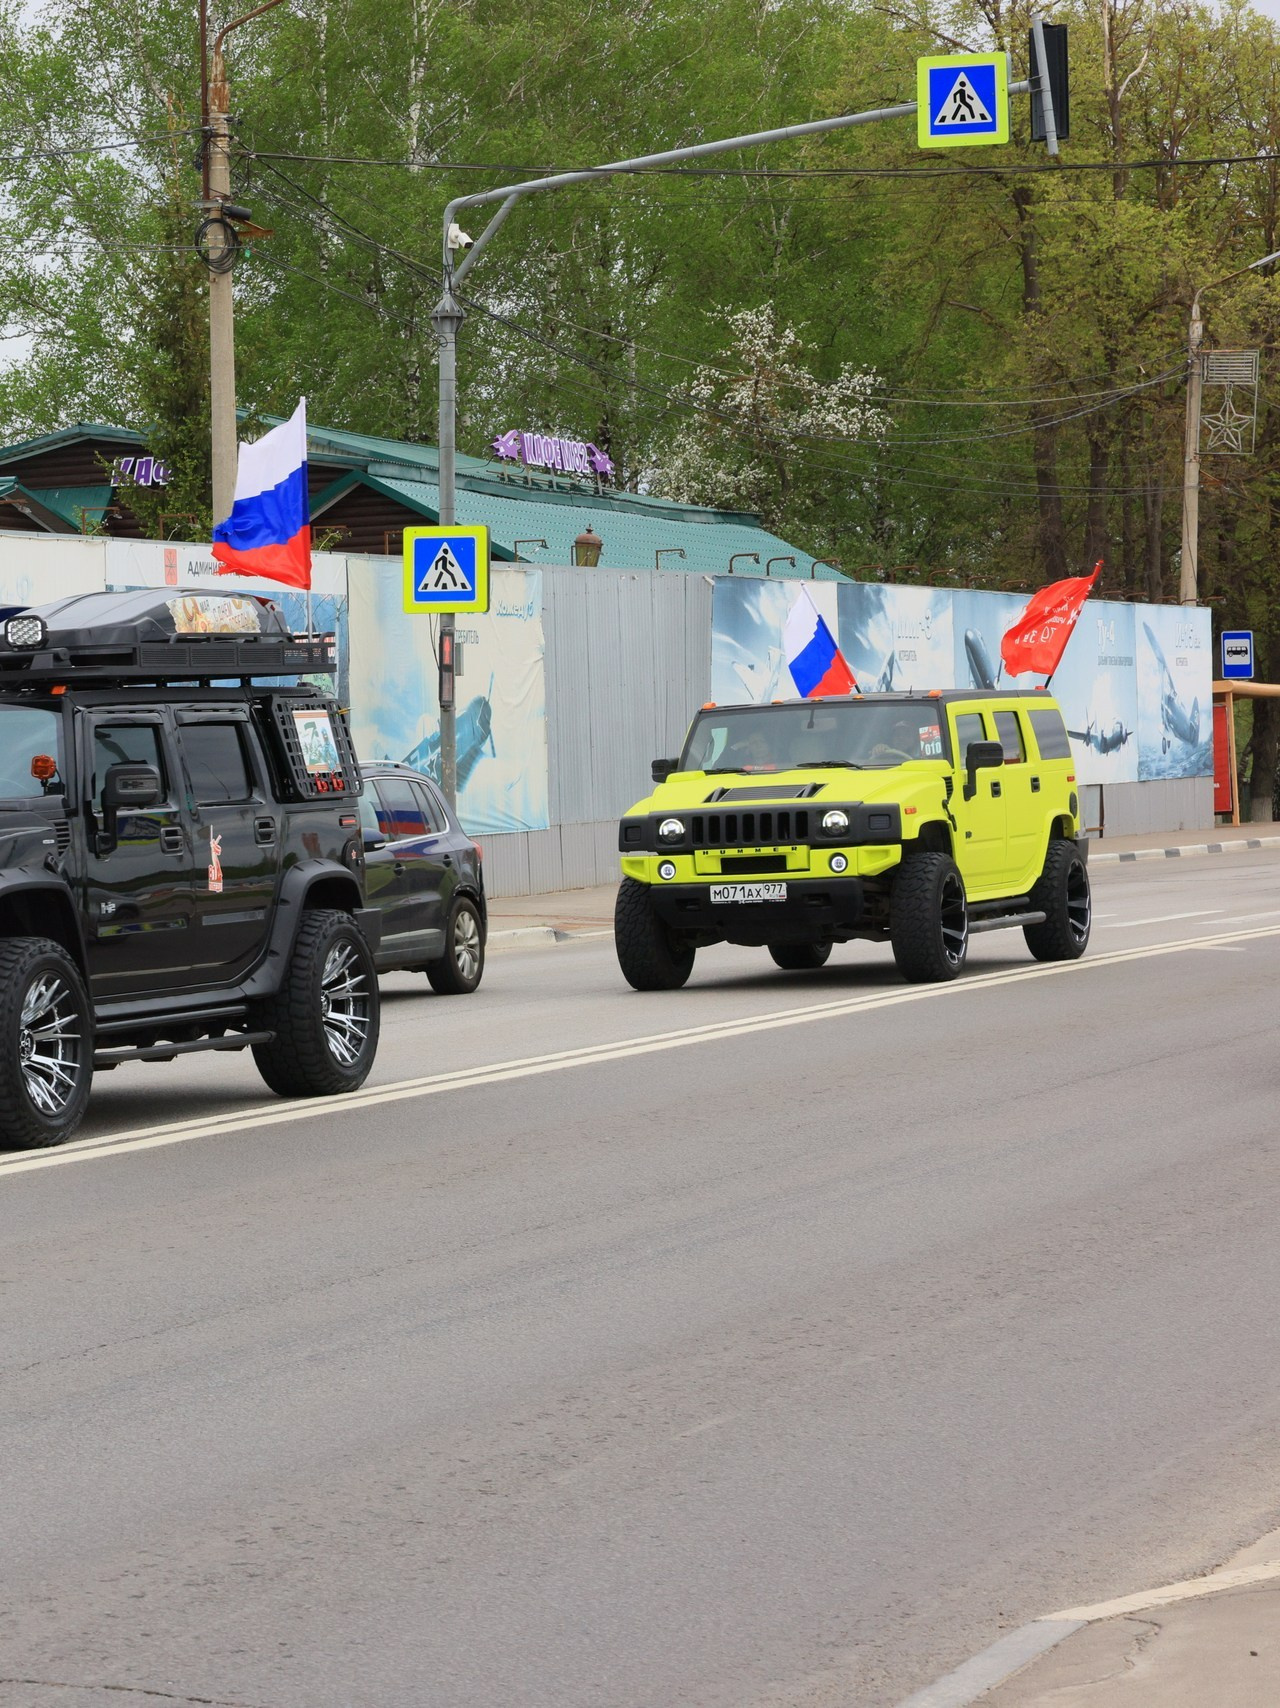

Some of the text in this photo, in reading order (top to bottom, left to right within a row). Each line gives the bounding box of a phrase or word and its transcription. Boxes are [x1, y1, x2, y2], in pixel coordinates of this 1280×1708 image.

[523, 432, 562, 469] КАФЕ
[925, 741, 942, 755] 010
[702, 846, 798, 855] HUMMER
[713, 884, 783, 899] М071АХ 977
